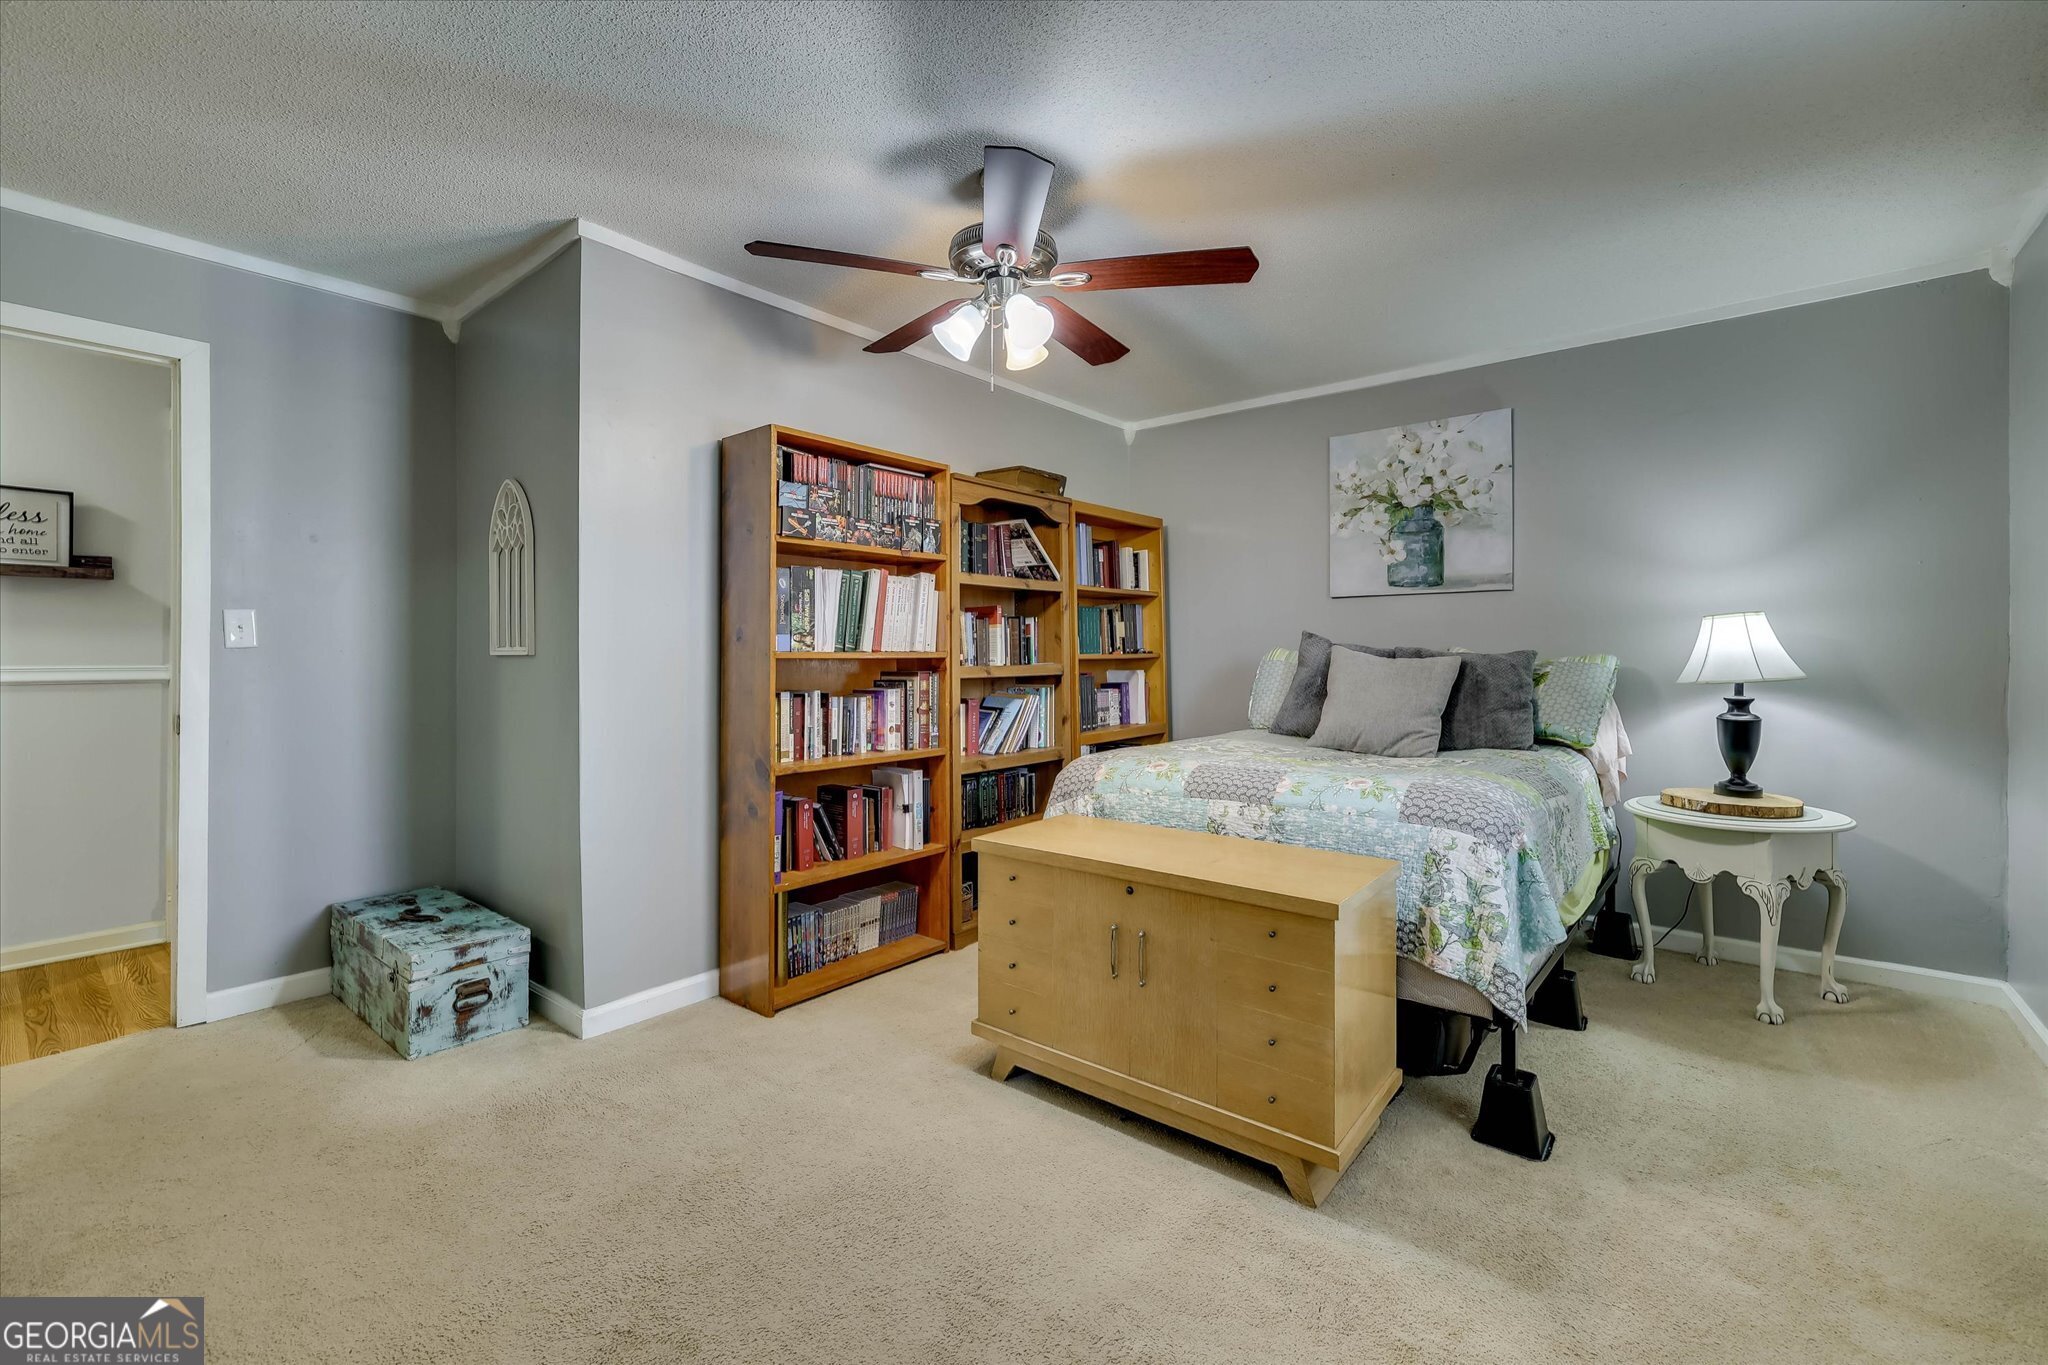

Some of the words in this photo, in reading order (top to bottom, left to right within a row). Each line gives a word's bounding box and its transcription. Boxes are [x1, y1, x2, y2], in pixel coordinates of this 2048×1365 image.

[8, 523, 47, 536] home
[20, 537, 38, 545] all
[12, 547, 48, 555] enter
